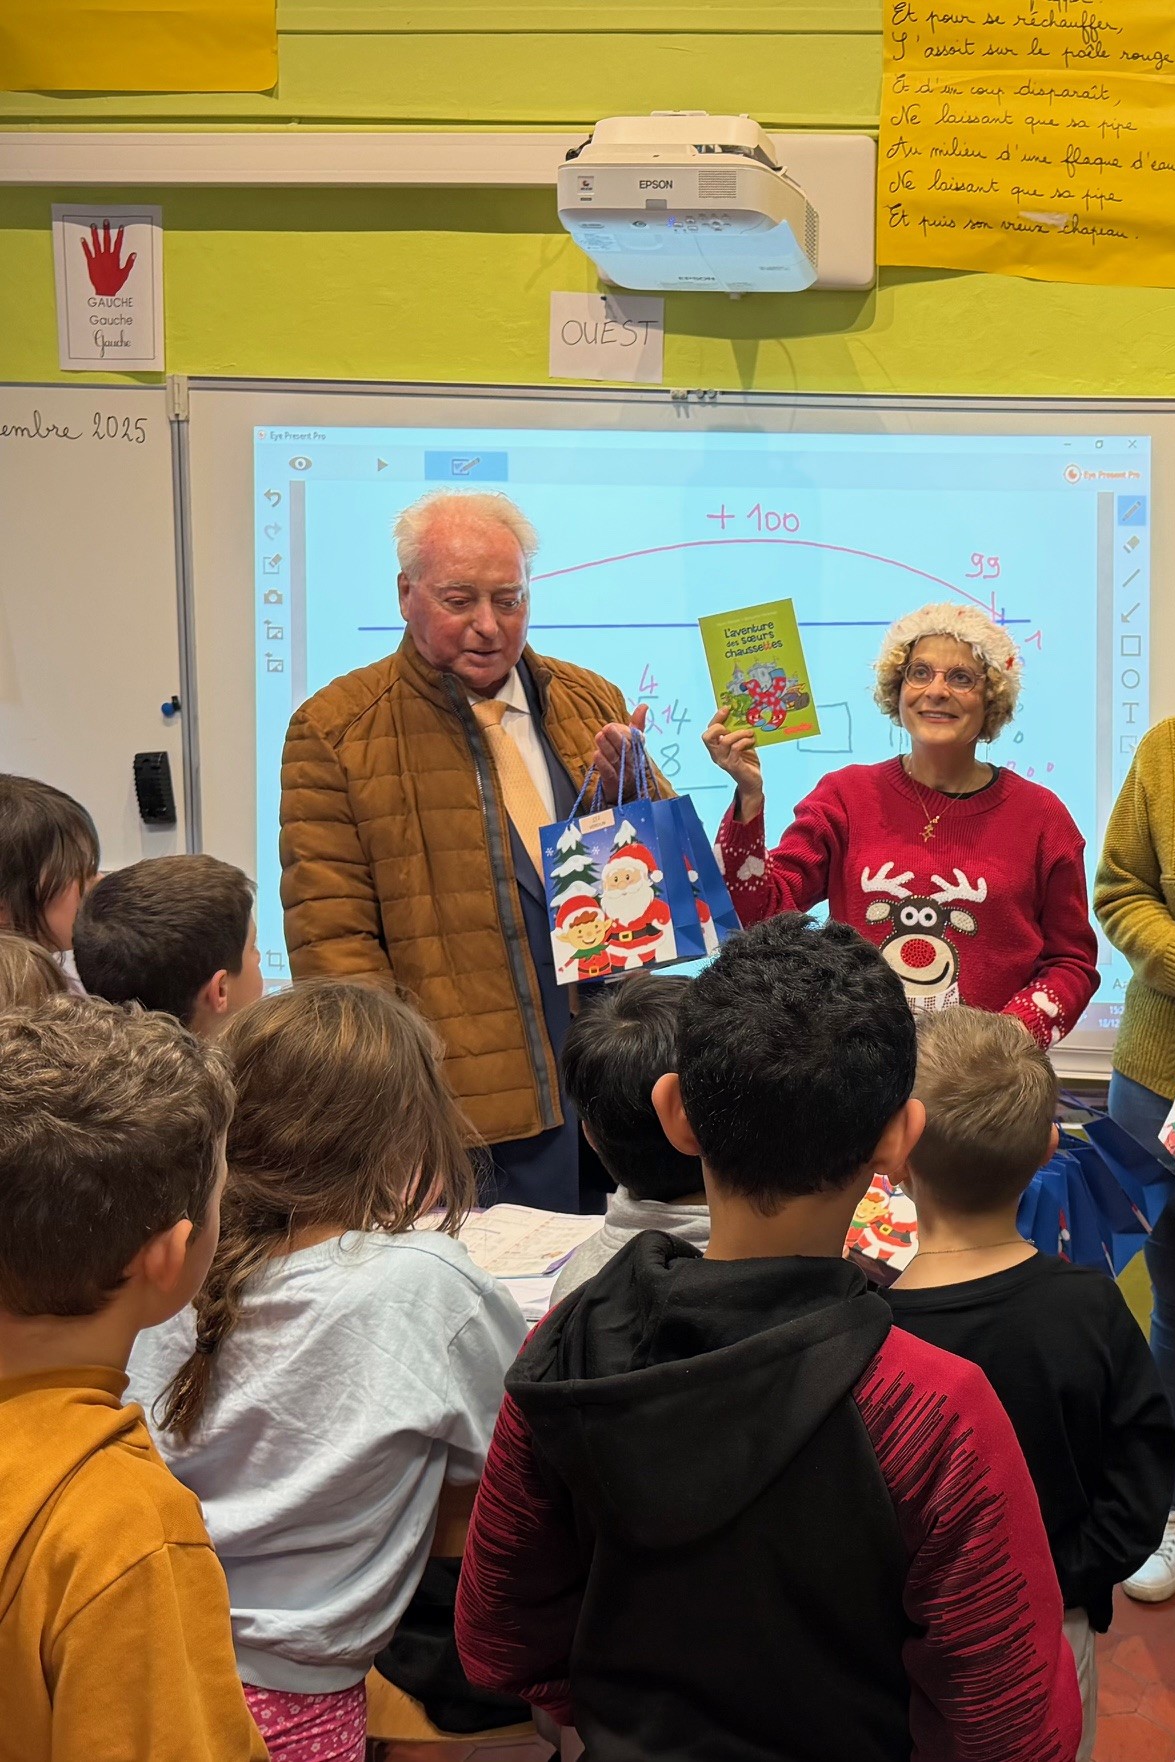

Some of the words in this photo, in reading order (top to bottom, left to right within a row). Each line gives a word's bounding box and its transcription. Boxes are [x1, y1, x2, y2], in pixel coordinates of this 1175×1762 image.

[892, 0, 917, 25] Et
[927, 13, 975, 33] pour
[983, 13, 1004, 25] se
[1013, 11, 1123, 43] réchauffer,
[982, 43, 1017, 56] sur
[1027, 39, 1049, 56] le
[1062, 42, 1109, 68] poêle
[1119, 51, 1174, 71] rouge
[971, 87, 1005, 106] coup
[1014, 79, 1122, 107] disparaît,
[891, 104, 921, 125] Ne
[934, 105, 1014, 126] laissant
[1024, 115, 1059, 135] que
[1067, 119, 1090, 129] sa
[1098, 120, 1138, 139] pipe
[887, 137, 922, 158] Au
[930, 139, 986, 159] milieu
[997, 144, 1052, 165] d'une
[1060, 144, 1122, 178] flaque
[639, 180, 673, 189] EPSON
[889, 170, 916, 191] Ne
[928, 170, 1000, 194] laissant
[1011, 184, 1043, 204] que
[1050, 187, 1075, 200] sa
[1082, 188, 1123, 211] pipe
[884, 203, 909, 229] Et
[918, 214, 956, 237] puis
[963, 219, 993, 231] son
[1000, 218, 1049, 235] vieux
[87, 298, 134, 308] GAUCHE
[89, 314, 133, 325] Gauche
[561, 320, 659, 347] OUEST
[93, 329, 131, 357] Gauche
[93, 412, 148, 443] 2025
[270, 431, 283, 441] Eye
[285, 432, 311, 440] Present
[313, 432, 326, 440] Pro
[747, 503, 800, 532] 100
[724, 621, 774, 638] L'aventure
[725, 639, 783, 659] chaussettes
